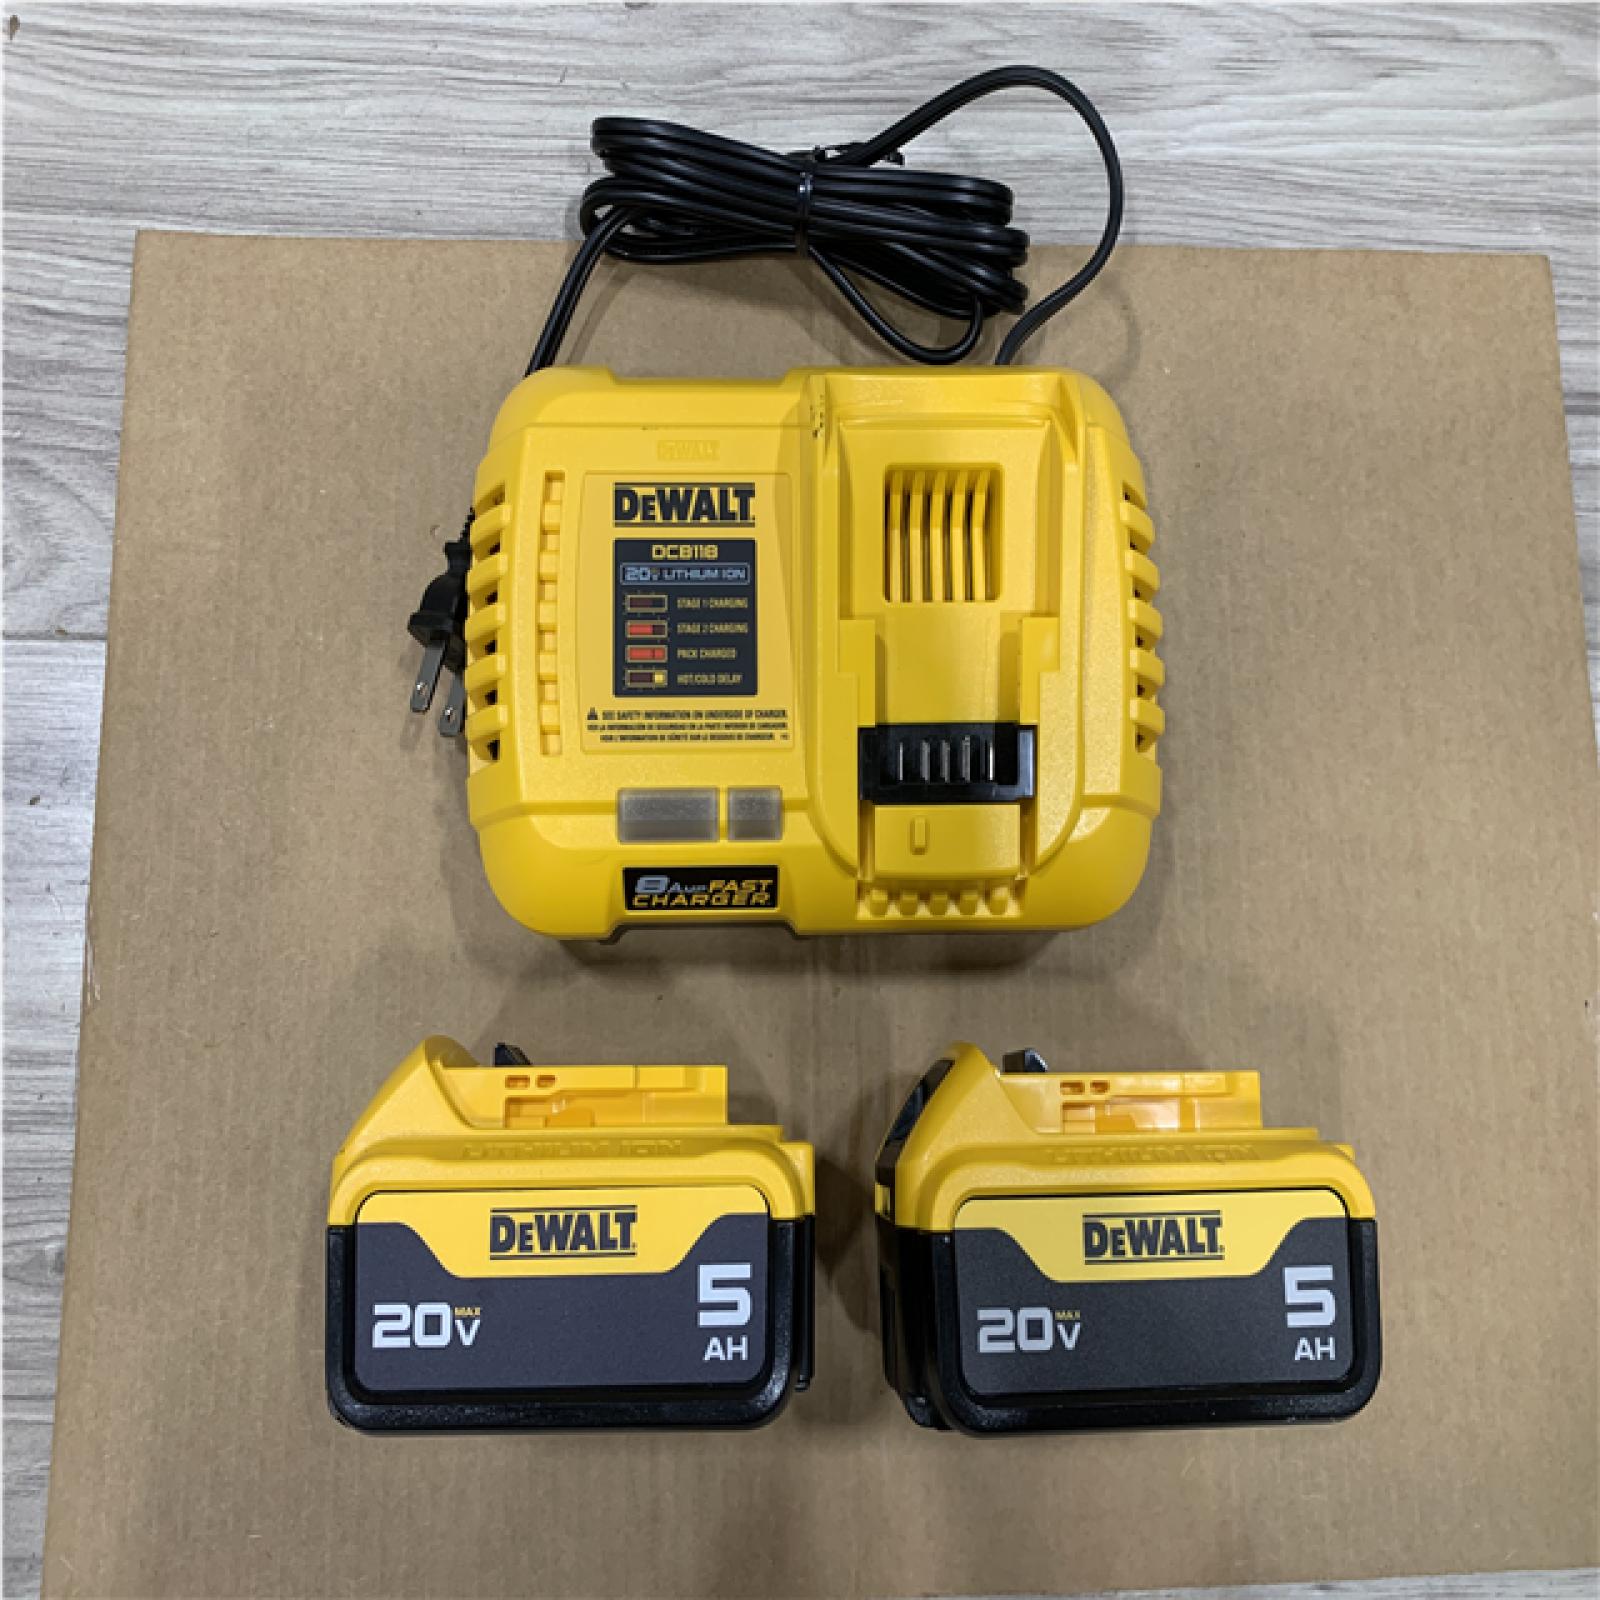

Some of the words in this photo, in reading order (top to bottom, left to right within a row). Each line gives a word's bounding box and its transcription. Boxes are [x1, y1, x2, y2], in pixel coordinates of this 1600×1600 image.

[614, 485, 755, 524] DEWALT
[652, 544, 718, 560] DCB118
[663, 568, 718, 580] LITHIUM
[721, 568, 747, 580] ION
[709, 597, 748, 609] CHARGING
[709, 622, 748, 634] CHARGING
[709, 879, 773, 893] FAST
[632, 892, 773, 907] CHARGER
[490, 1208, 638, 1257] DEWALT
[1083, 1213, 1225, 1263] DEWALT
[698, 1262, 752, 1328] 5
[1284, 1264, 1336, 1329] 5
[703, 1336, 749, 1362] AH
[1294, 1336, 1336, 1362] AH
